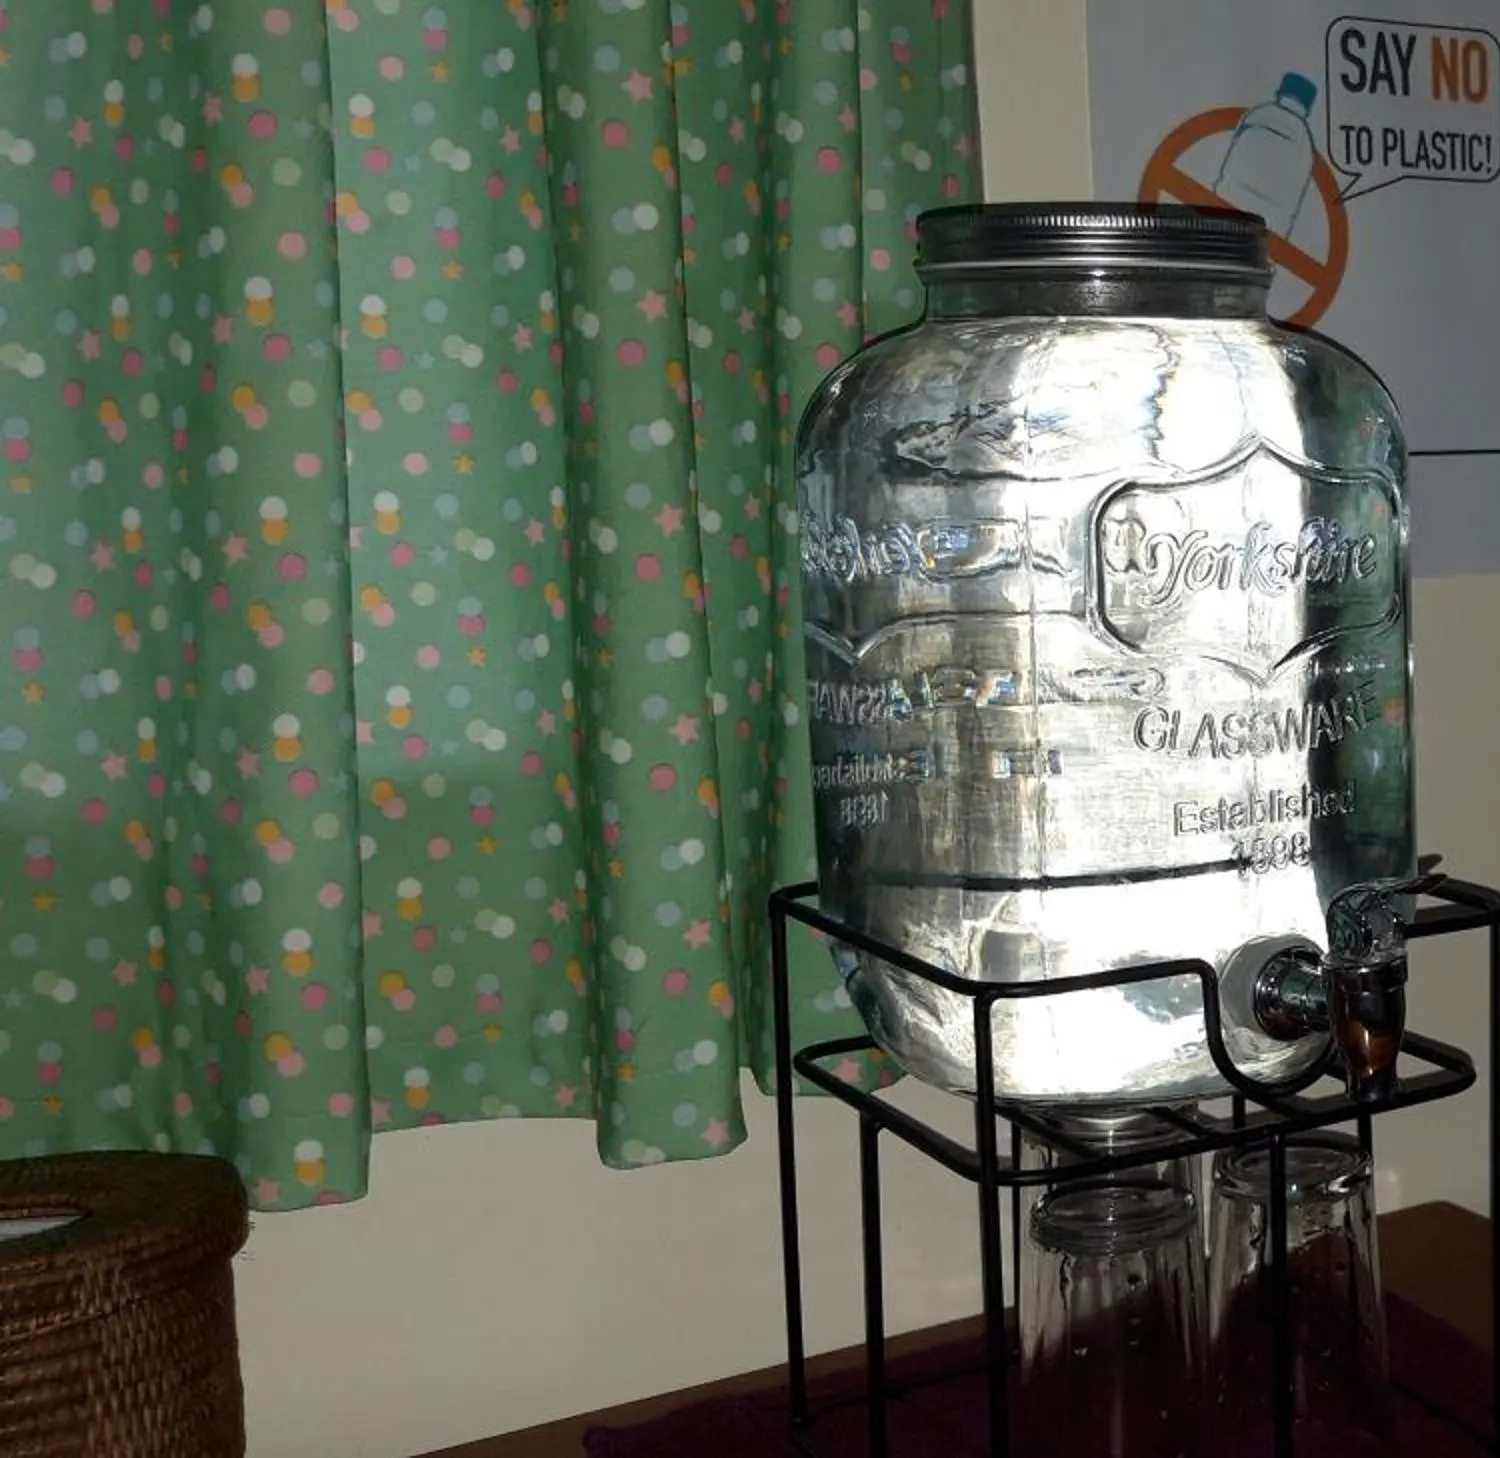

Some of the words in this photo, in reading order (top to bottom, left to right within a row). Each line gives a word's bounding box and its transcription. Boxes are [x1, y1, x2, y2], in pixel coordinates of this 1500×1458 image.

[1340, 26, 1416, 96] SAY
[1431, 36, 1488, 103] NO
[1339, 125, 1373, 165] TO
[1383, 127, 1492, 173] PLASTIC!
[1143, 515, 1377, 604] Yorkshire
[1133, 680, 1378, 759] GLASSWARE
[1173, 779, 1356, 837] Established
